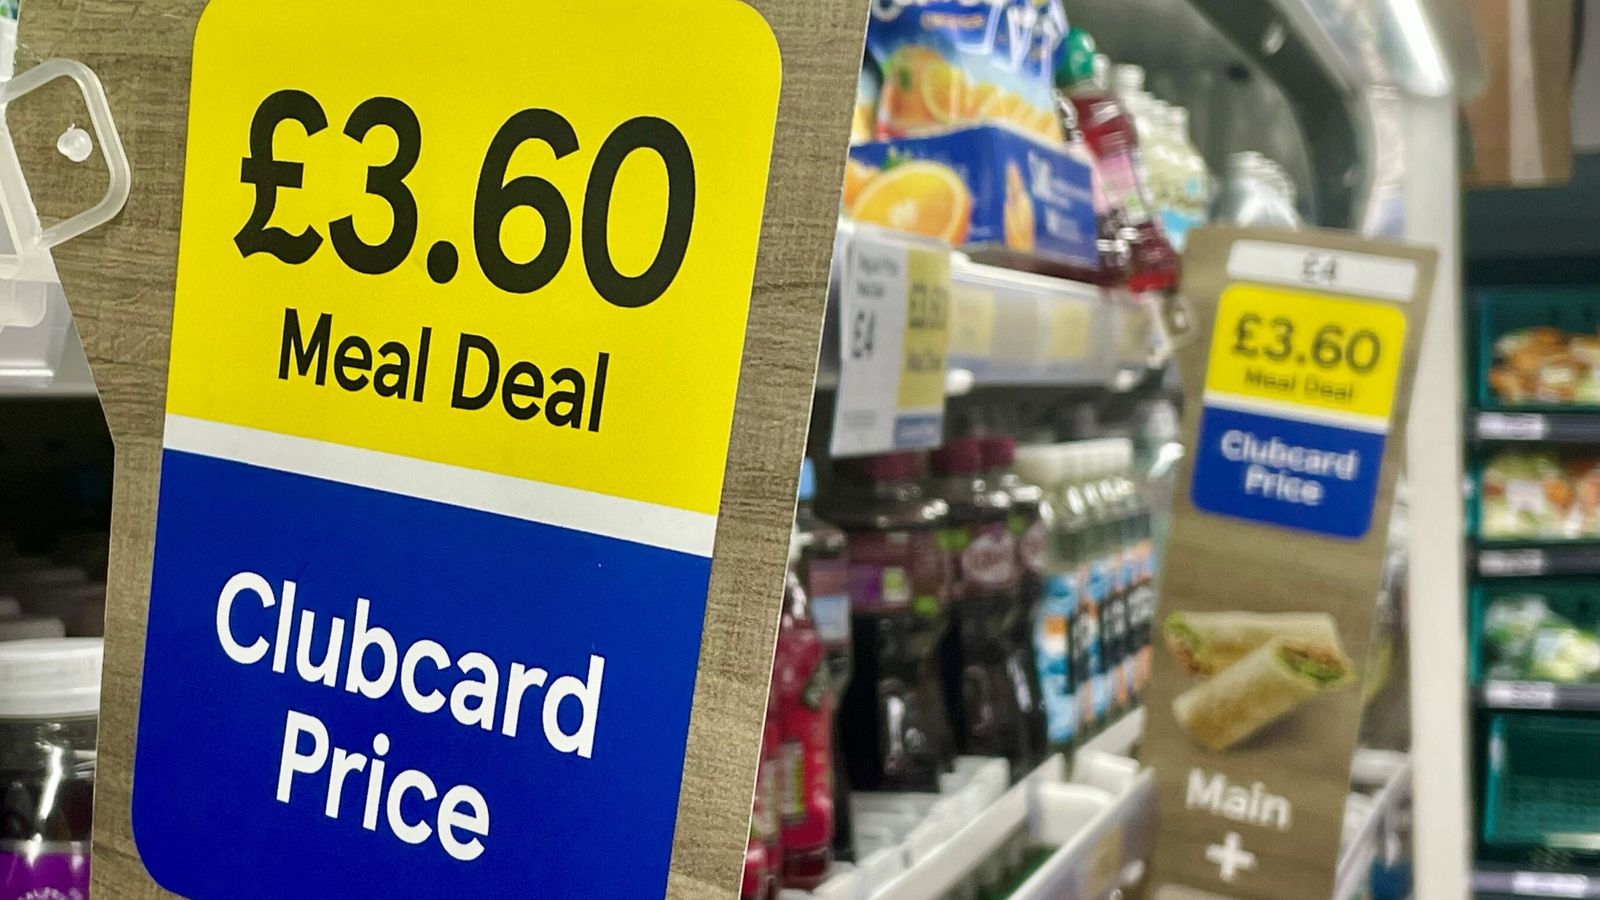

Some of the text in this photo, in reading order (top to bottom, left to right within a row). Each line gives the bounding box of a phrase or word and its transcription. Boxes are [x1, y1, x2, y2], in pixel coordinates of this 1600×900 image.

[234, 89, 696, 309] £3.60
[1303, 251, 1338, 285] £4
[278, 307, 609, 432] Meal Deal
[1233, 312, 1381, 373] £3.60
[1244, 368, 1354, 401] Meal Deal
[1220, 429, 1359, 481] Clubcard
[1244, 463, 1323, 506] Price
[216, 571, 604, 758] Clubcard
[276, 709, 490, 861] Price
[1185, 767, 1293, 831] Main
